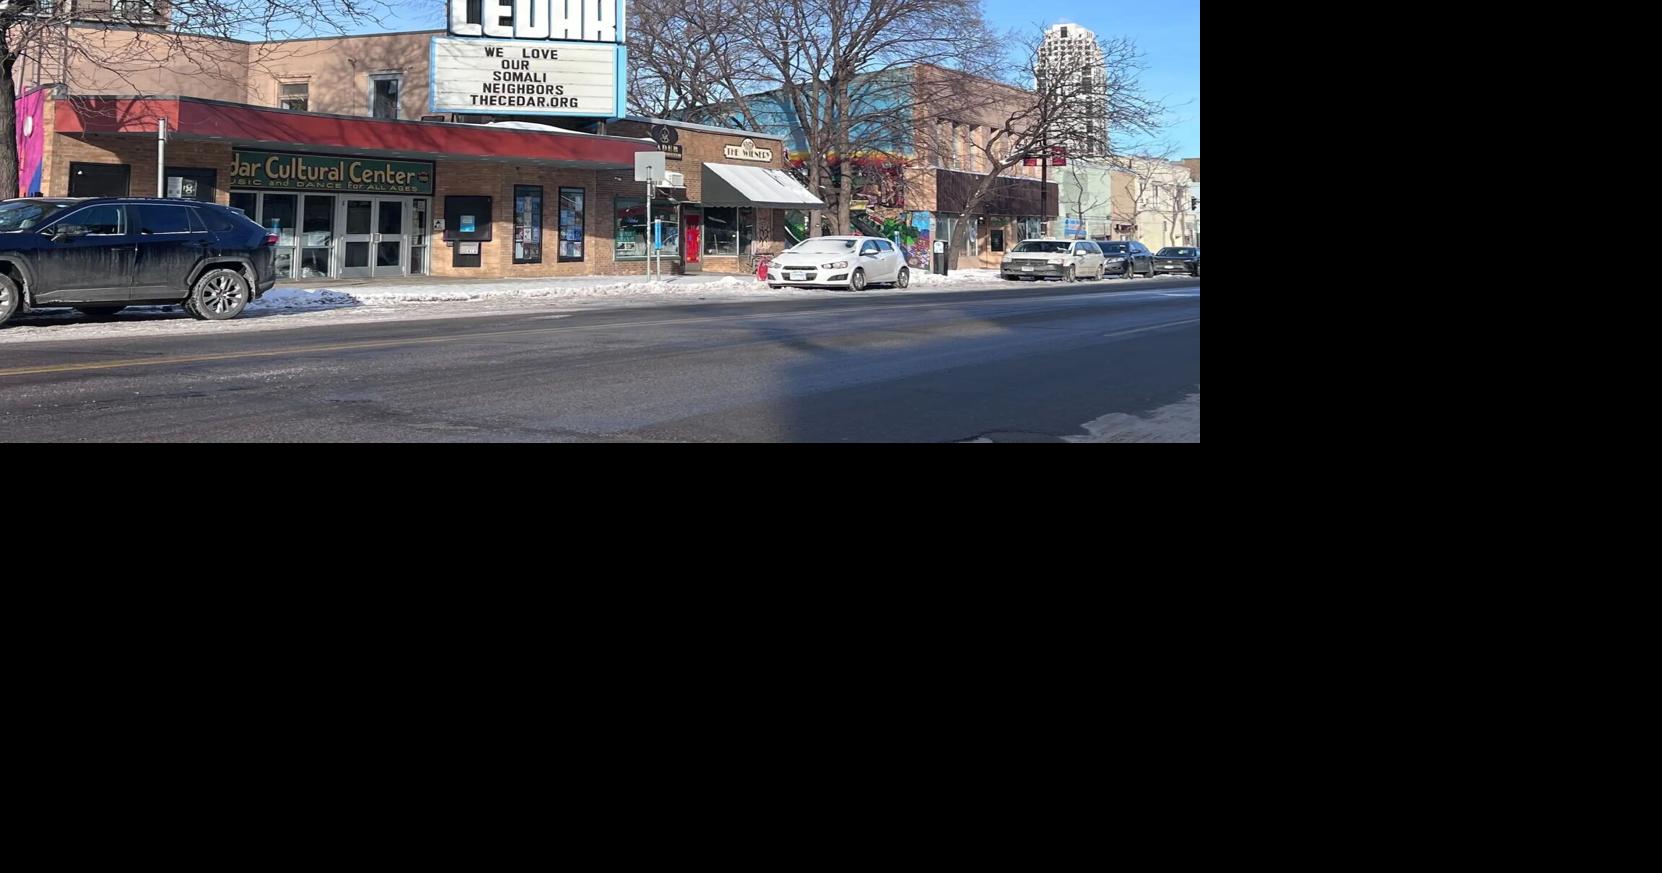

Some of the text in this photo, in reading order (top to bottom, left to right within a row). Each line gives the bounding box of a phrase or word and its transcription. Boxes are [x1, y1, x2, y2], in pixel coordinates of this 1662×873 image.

[484, 46, 558, 60] WE LOVE
[501, 59, 530, 71] OUR
[492, 71, 547, 83] SOMALI
[482, 82, 564, 96] NEIGHBORS
[469, 95, 579, 108] THECEDAR.ORG
[265, 156, 345, 182] Cultural
[349, 161, 416, 184] Center
[269, 179, 289, 187] and
[296, 181, 342, 189] DANCE
